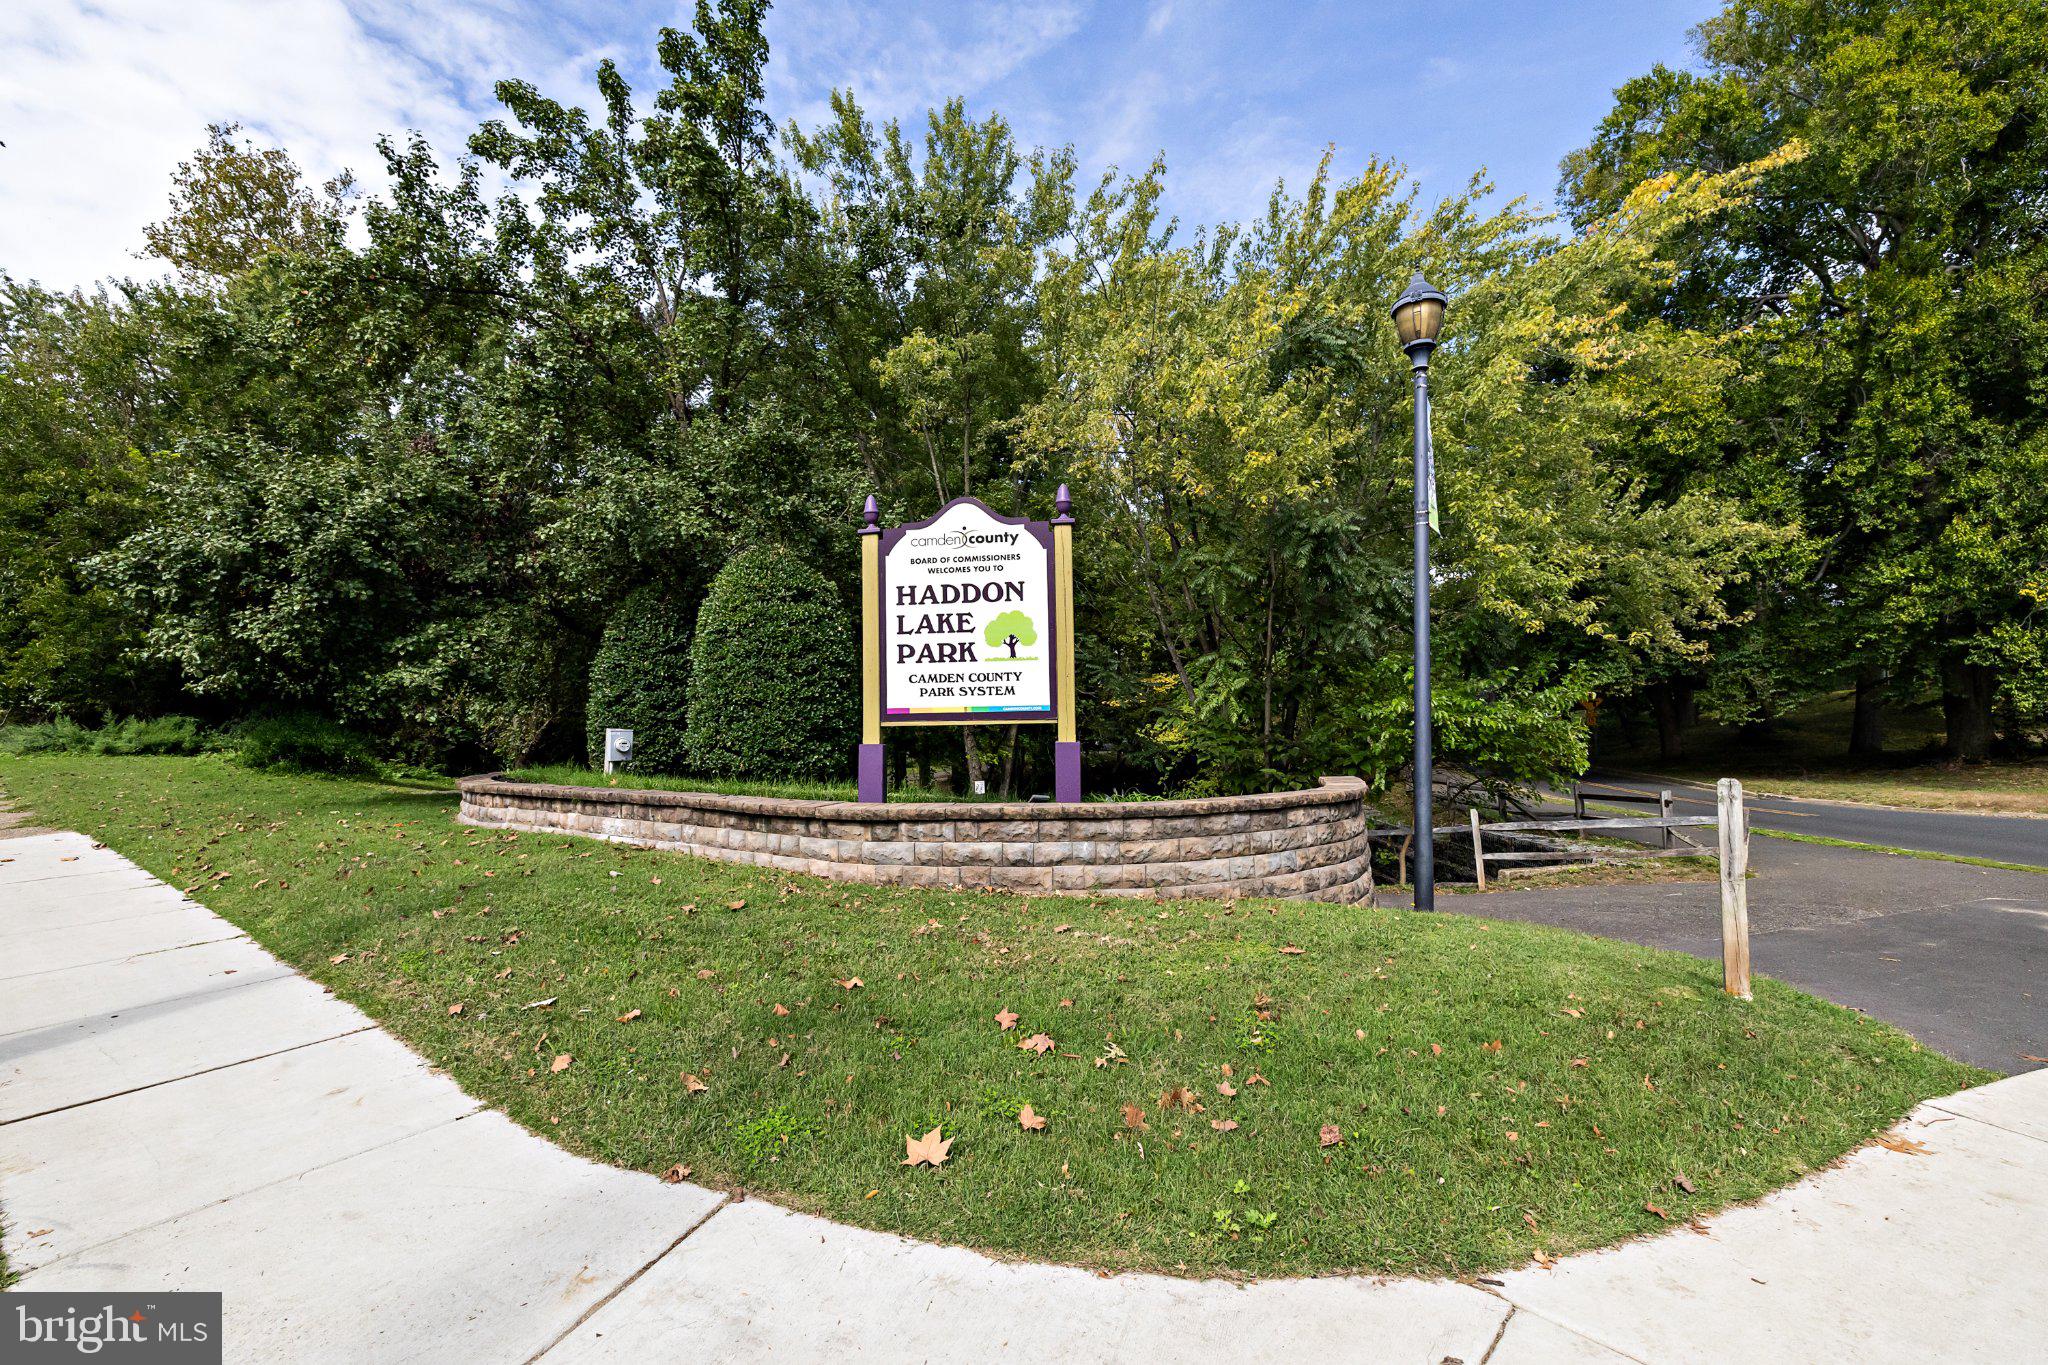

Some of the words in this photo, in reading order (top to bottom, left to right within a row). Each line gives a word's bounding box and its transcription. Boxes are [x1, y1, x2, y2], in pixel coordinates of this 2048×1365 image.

[911, 533, 960, 547] camden
[969, 532, 1019, 545] county
[953, 553, 1021, 563] COMMISSIONERS
[928, 566, 971, 574] WELCOMES
[896, 581, 1025, 605] HADDON
[897, 612, 975, 635] LAKE
[897, 642, 978, 664] PARK
[909, 673, 964, 683] CAMDEN
[969, 672, 1022, 682] COUNTY
[920, 688, 954, 697] PARK
[959, 686, 1015, 696] SYSTEM
